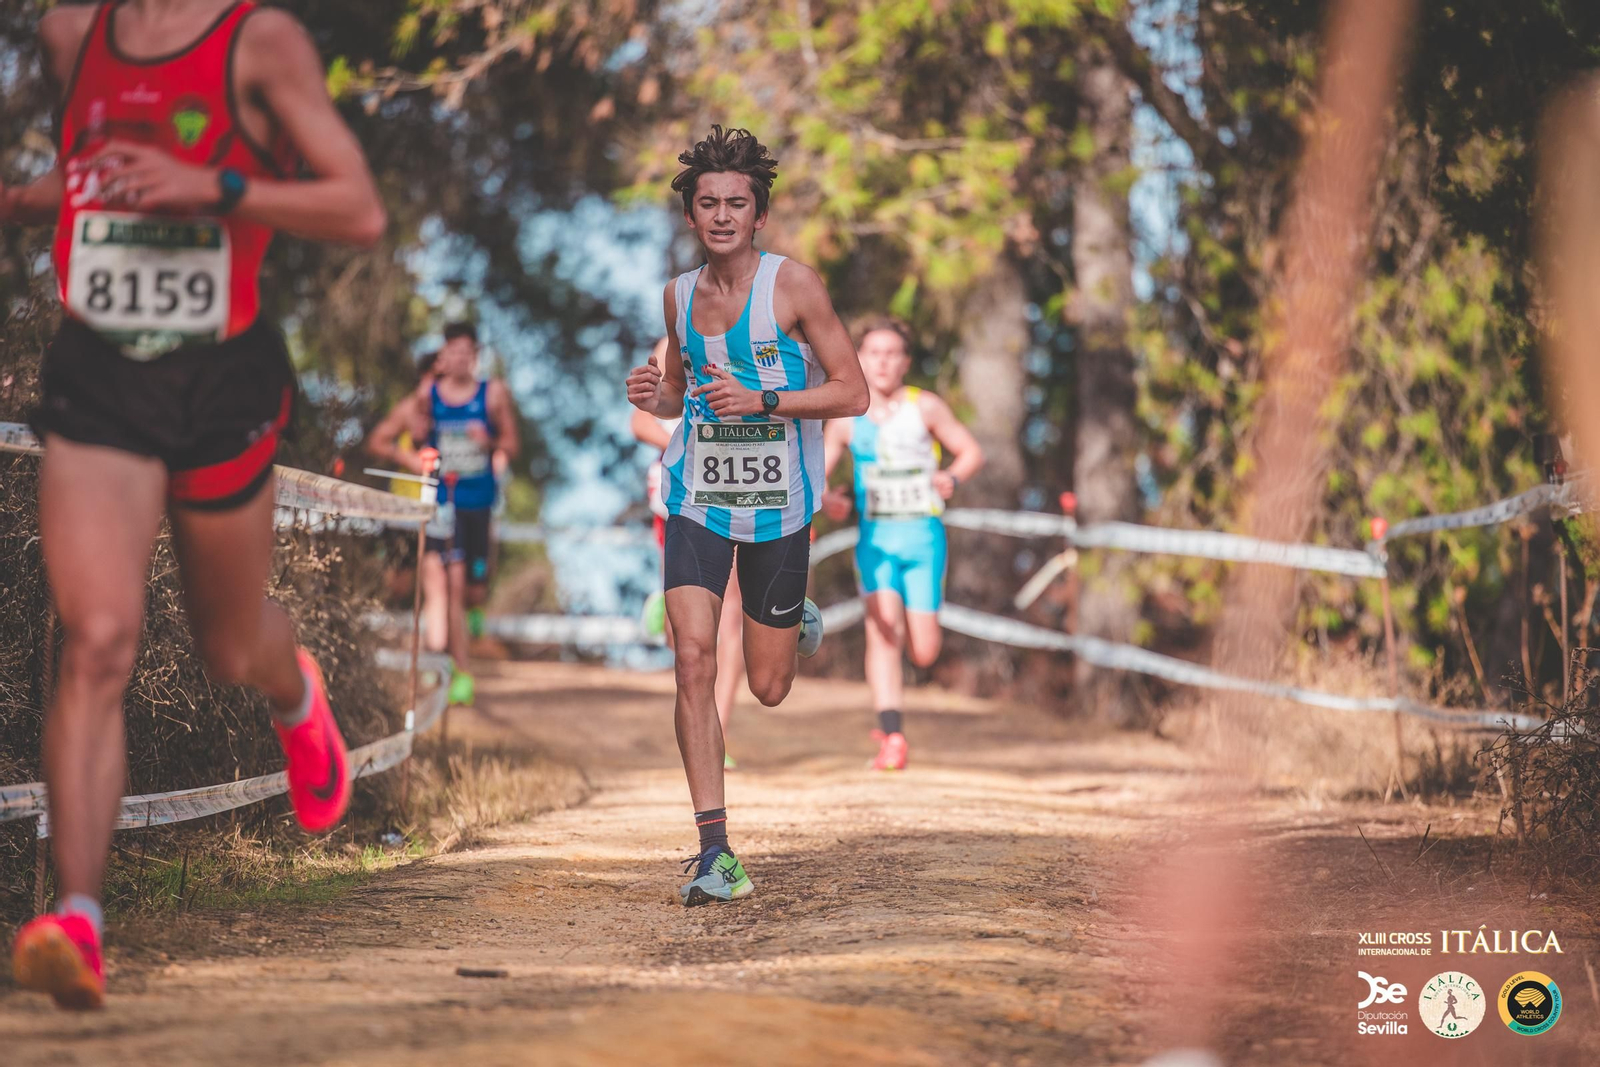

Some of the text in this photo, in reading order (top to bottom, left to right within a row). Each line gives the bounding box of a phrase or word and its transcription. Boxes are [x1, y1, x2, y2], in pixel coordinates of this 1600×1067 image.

[86, 268, 216, 316] 8159
[719, 425, 762, 437] ITÁLICA
[703, 455, 782, 485] 8158
